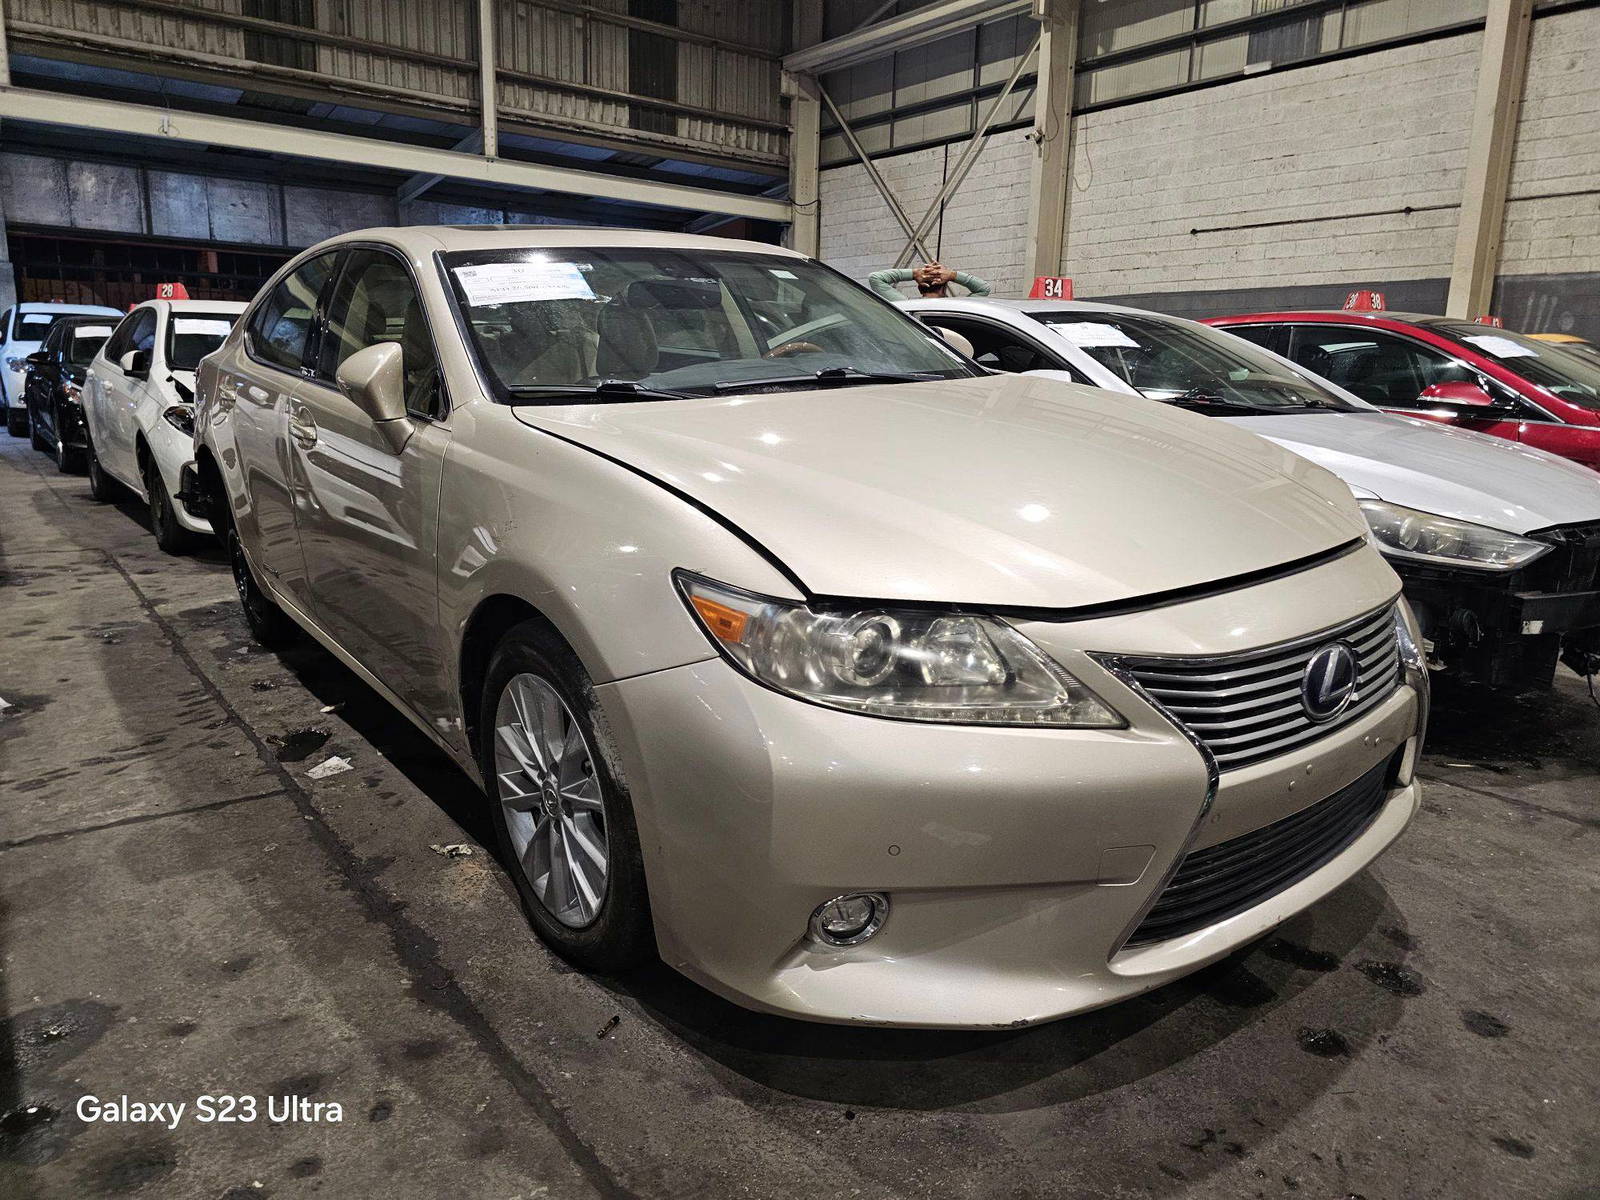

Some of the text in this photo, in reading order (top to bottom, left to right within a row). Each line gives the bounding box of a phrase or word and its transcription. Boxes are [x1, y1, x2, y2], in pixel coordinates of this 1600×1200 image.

[161, 283, 174, 298] 28
[1044, 278, 1063, 298] 34
[1370, 292, 1382, 310] 38
